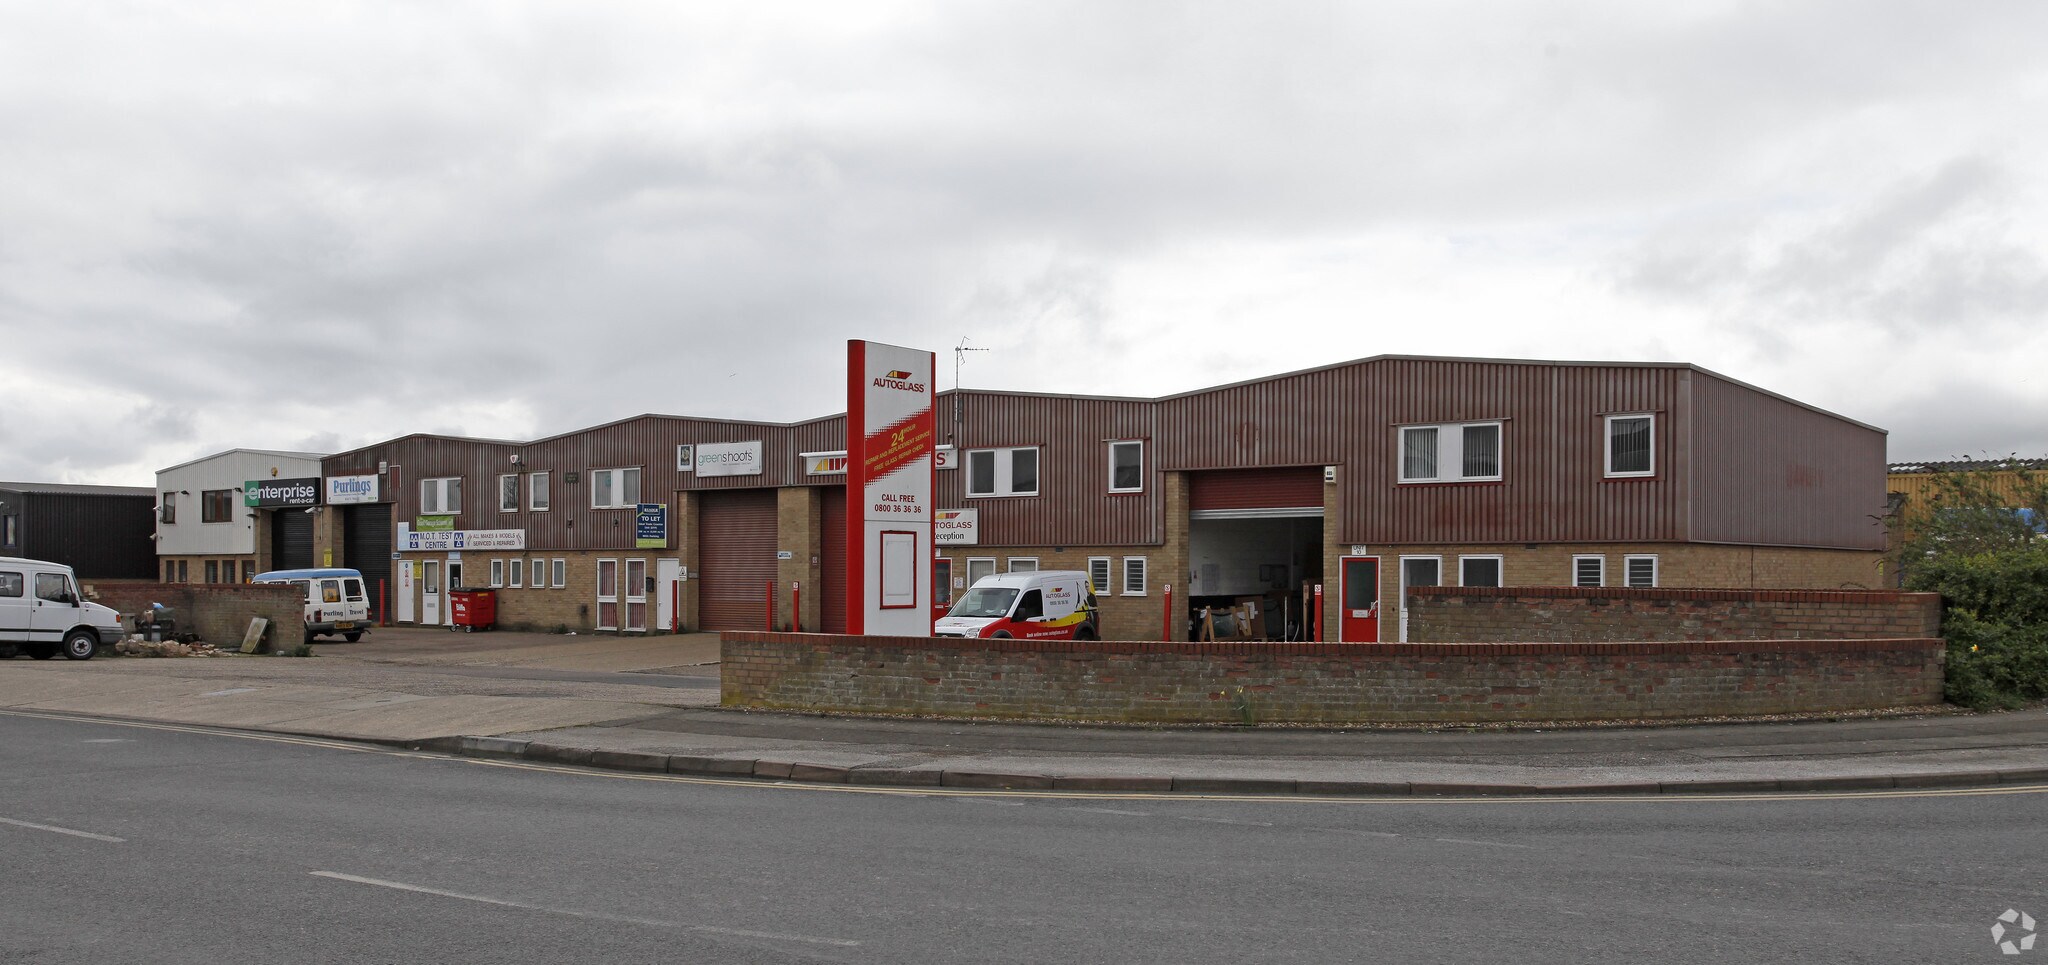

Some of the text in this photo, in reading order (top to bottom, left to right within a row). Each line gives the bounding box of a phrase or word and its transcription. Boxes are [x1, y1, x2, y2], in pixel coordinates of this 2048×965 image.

[873, 378, 924, 393] AUTOGLASS
[891, 424, 917, 447] 24 HOUR
[865, 431, 930, 466] REPAIR AND REPLACEMENT SERVICE
[698, 450, 753, 466] greenshoots
[874, 444, 924, 471] FREE GLASS REPAIR CHECK
[248, 483, 315, 502] enterprise
[334, 478, 372, 495] Purlings
[882, 494, 915, 503] CALL FREE
[875, 504, 922, 514] 0800 36 36 36
[420, 532, 453, 540] M.O.T. TEST
[935, 532, 965, 541] eception
[425, 541, 447, 549] CENTRE
